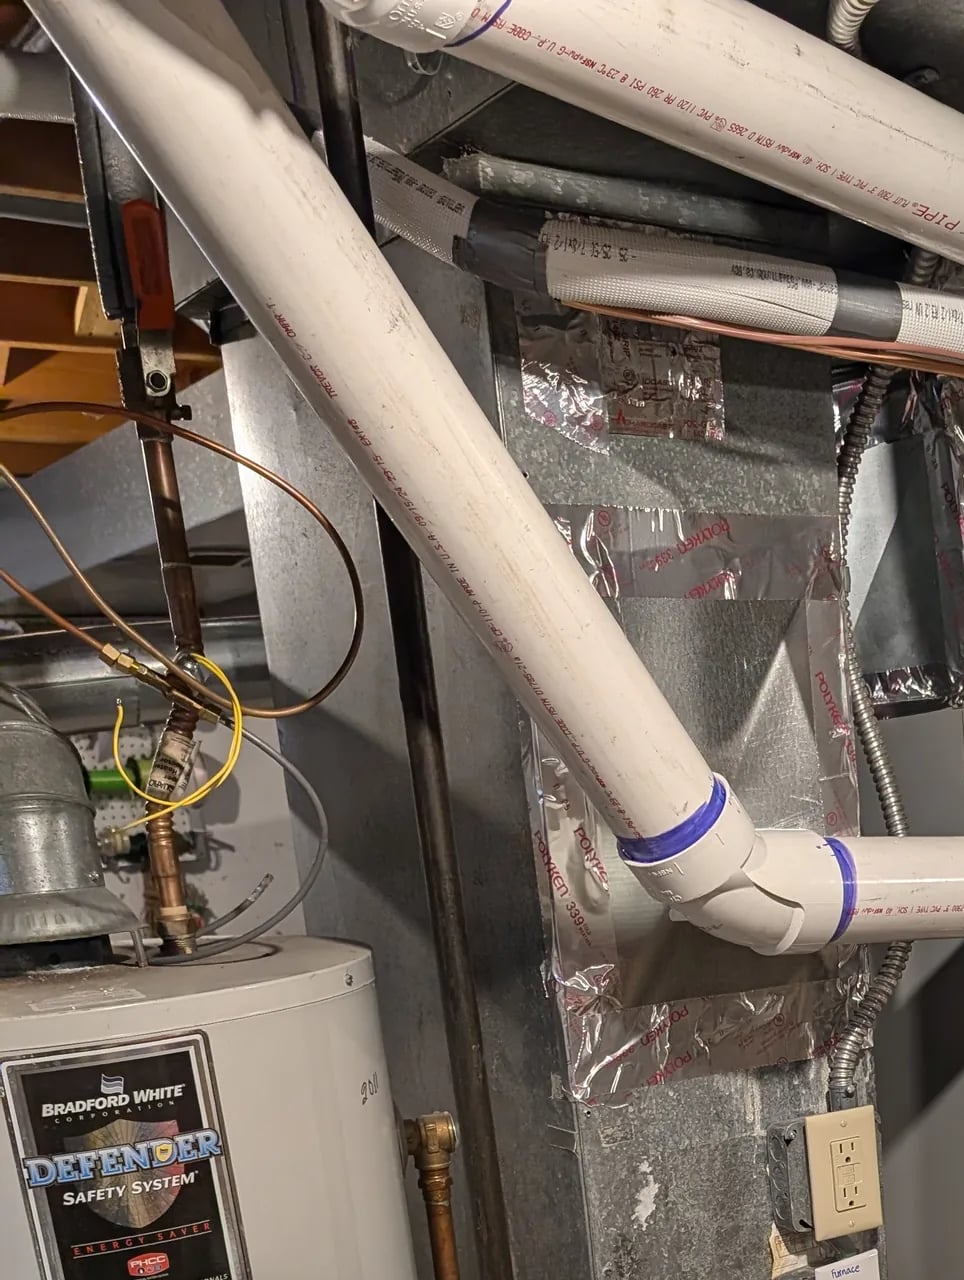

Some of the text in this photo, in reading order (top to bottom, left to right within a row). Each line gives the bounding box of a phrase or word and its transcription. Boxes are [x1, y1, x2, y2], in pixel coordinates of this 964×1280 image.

[507, 22, 532, 42] CODE
[628, 76, 647, 93] PSI
[663, 91, 676, 106] PR
[676, 97, 696, 115] 1120
[696, 107, 714, 123] PVC
[727, 121, 748, 137] 2665
[755, 134, 775, 149] ASTM
[275, 313, 296, 338] OMAR
[310, 364, 338, 399] TREVOR
[448, 563, 459, 573] IN
[456, 577, 476, 596] MADE
[534, 830, 569, 898] POLYKEN
[42, 1084, 184, 1118] BRADFORD WHITE
[55, 1100, 174, 1124] CORPORATION
[24, 1130, 222, 1188] DEFENDER
[63, 1184, 125, 1206] SAFETY
[73, 1222, 210, 1256] ENERGY SAVER
[130, 1255, 166, 1268] PHCC
